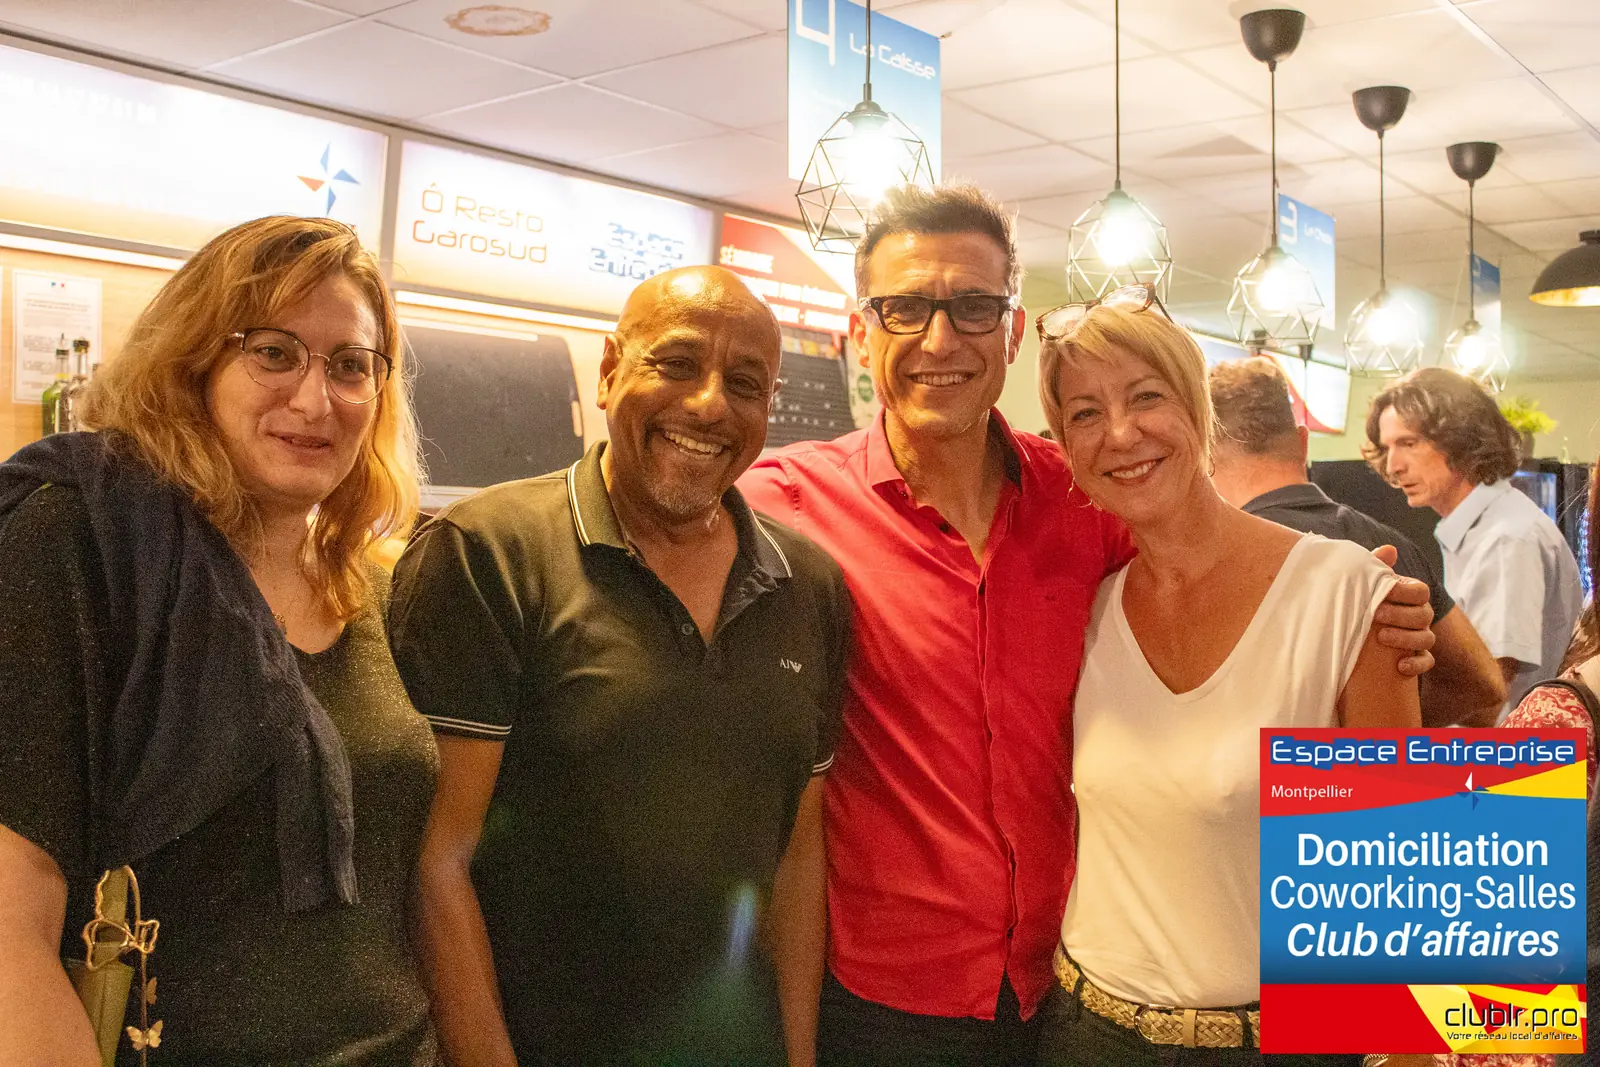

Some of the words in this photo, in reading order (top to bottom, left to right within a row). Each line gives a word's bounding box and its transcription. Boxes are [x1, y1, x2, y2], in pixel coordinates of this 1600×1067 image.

[878, 44, 936, 80] Caisse
[455, 196, 544, 233] Resto
[1280, 200, 1298, 245] 3
[412, 220, 548, 264] Garosud
